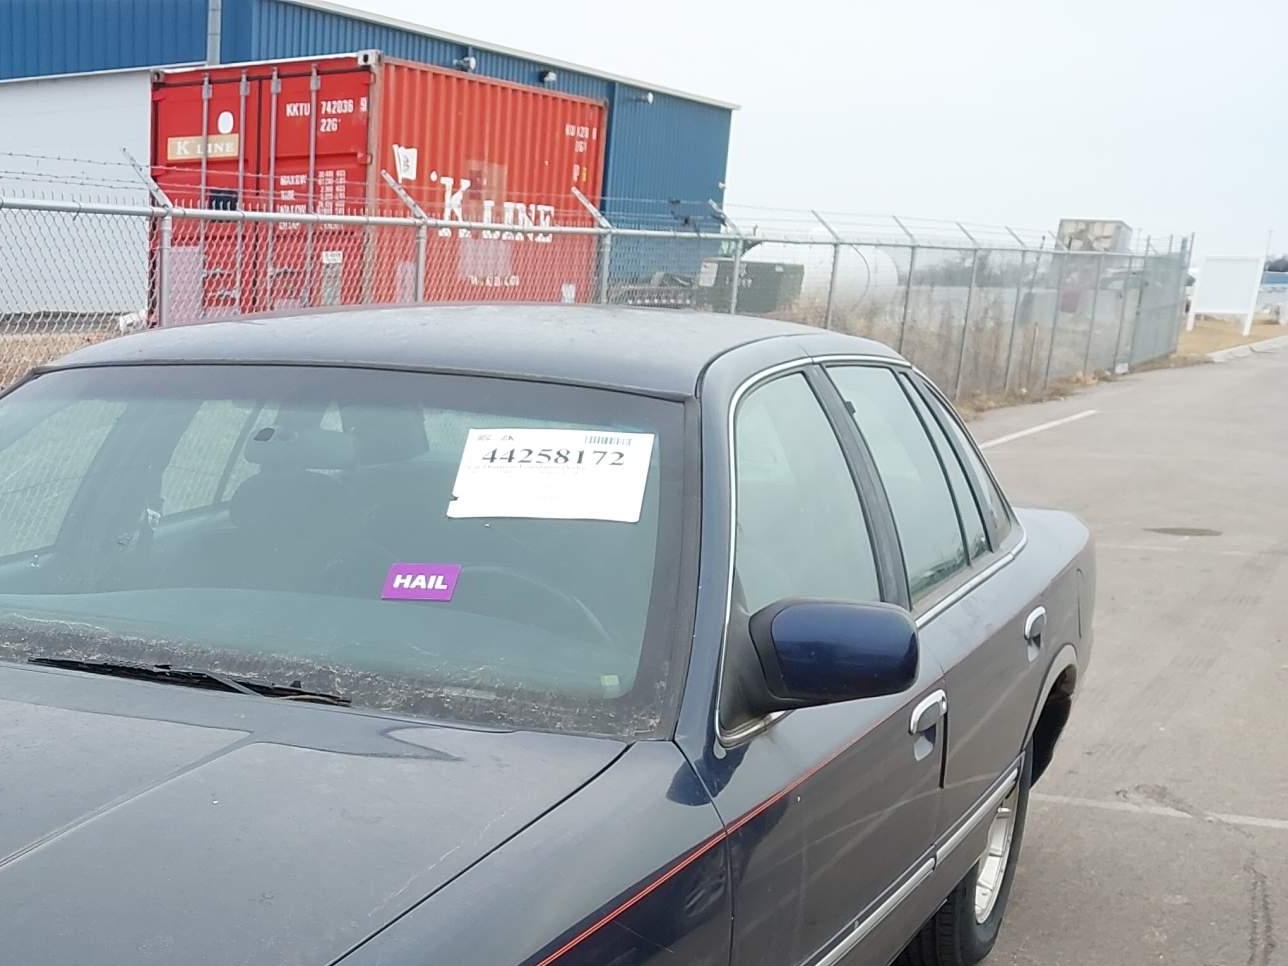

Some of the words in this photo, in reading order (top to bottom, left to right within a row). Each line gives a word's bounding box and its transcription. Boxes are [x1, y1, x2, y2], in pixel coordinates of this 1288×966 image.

[285, 102, 311, 117] KKTU
[175, 141, 190, 156] K
[195, 142, 235, 156] LINE
[482, 199, 555, 243] LINE
[481, 447, 626, 467] 44258172
[392, 574, 449, 591] HAIL
